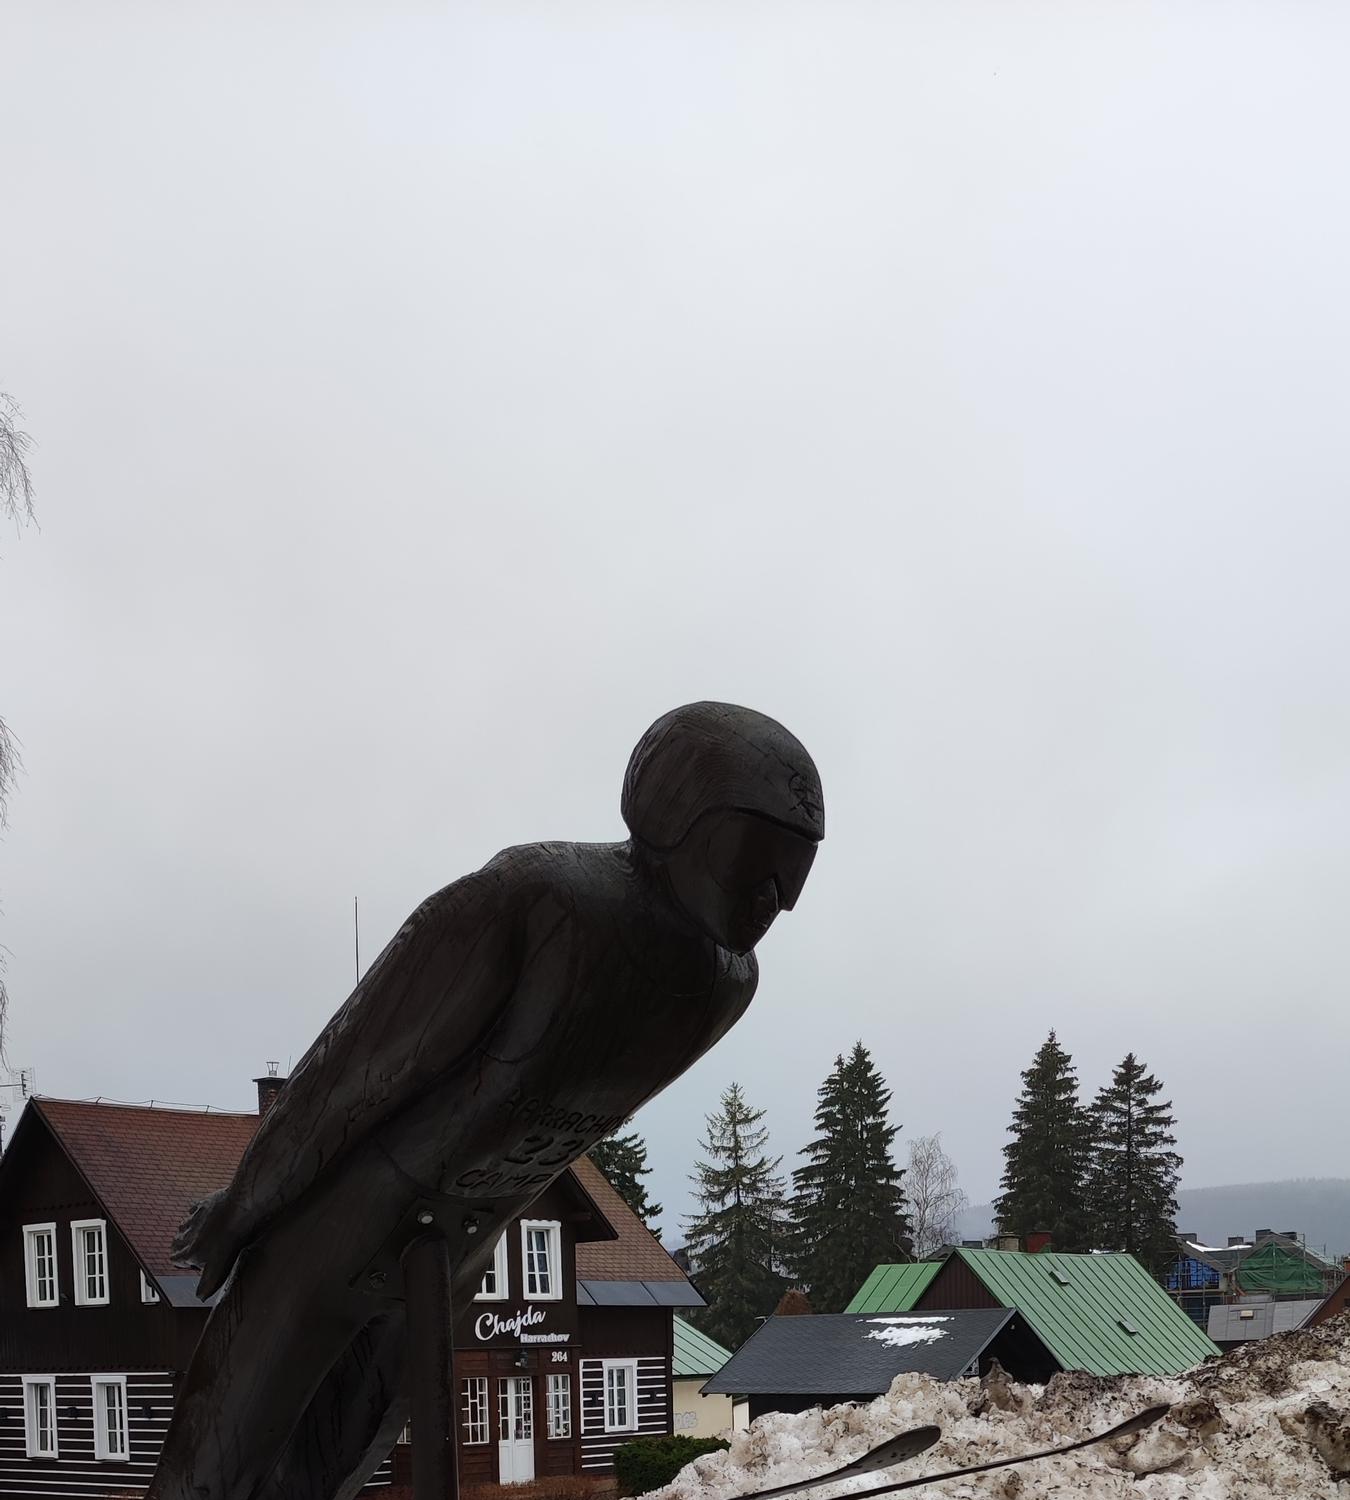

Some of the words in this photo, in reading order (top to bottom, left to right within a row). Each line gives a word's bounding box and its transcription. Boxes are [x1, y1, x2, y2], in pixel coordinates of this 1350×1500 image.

[474, 1305, 547, 1342] Chajda
[520, 1333, 570, 1344] Harrachov
[551, 1351, 568, 1362] 264
